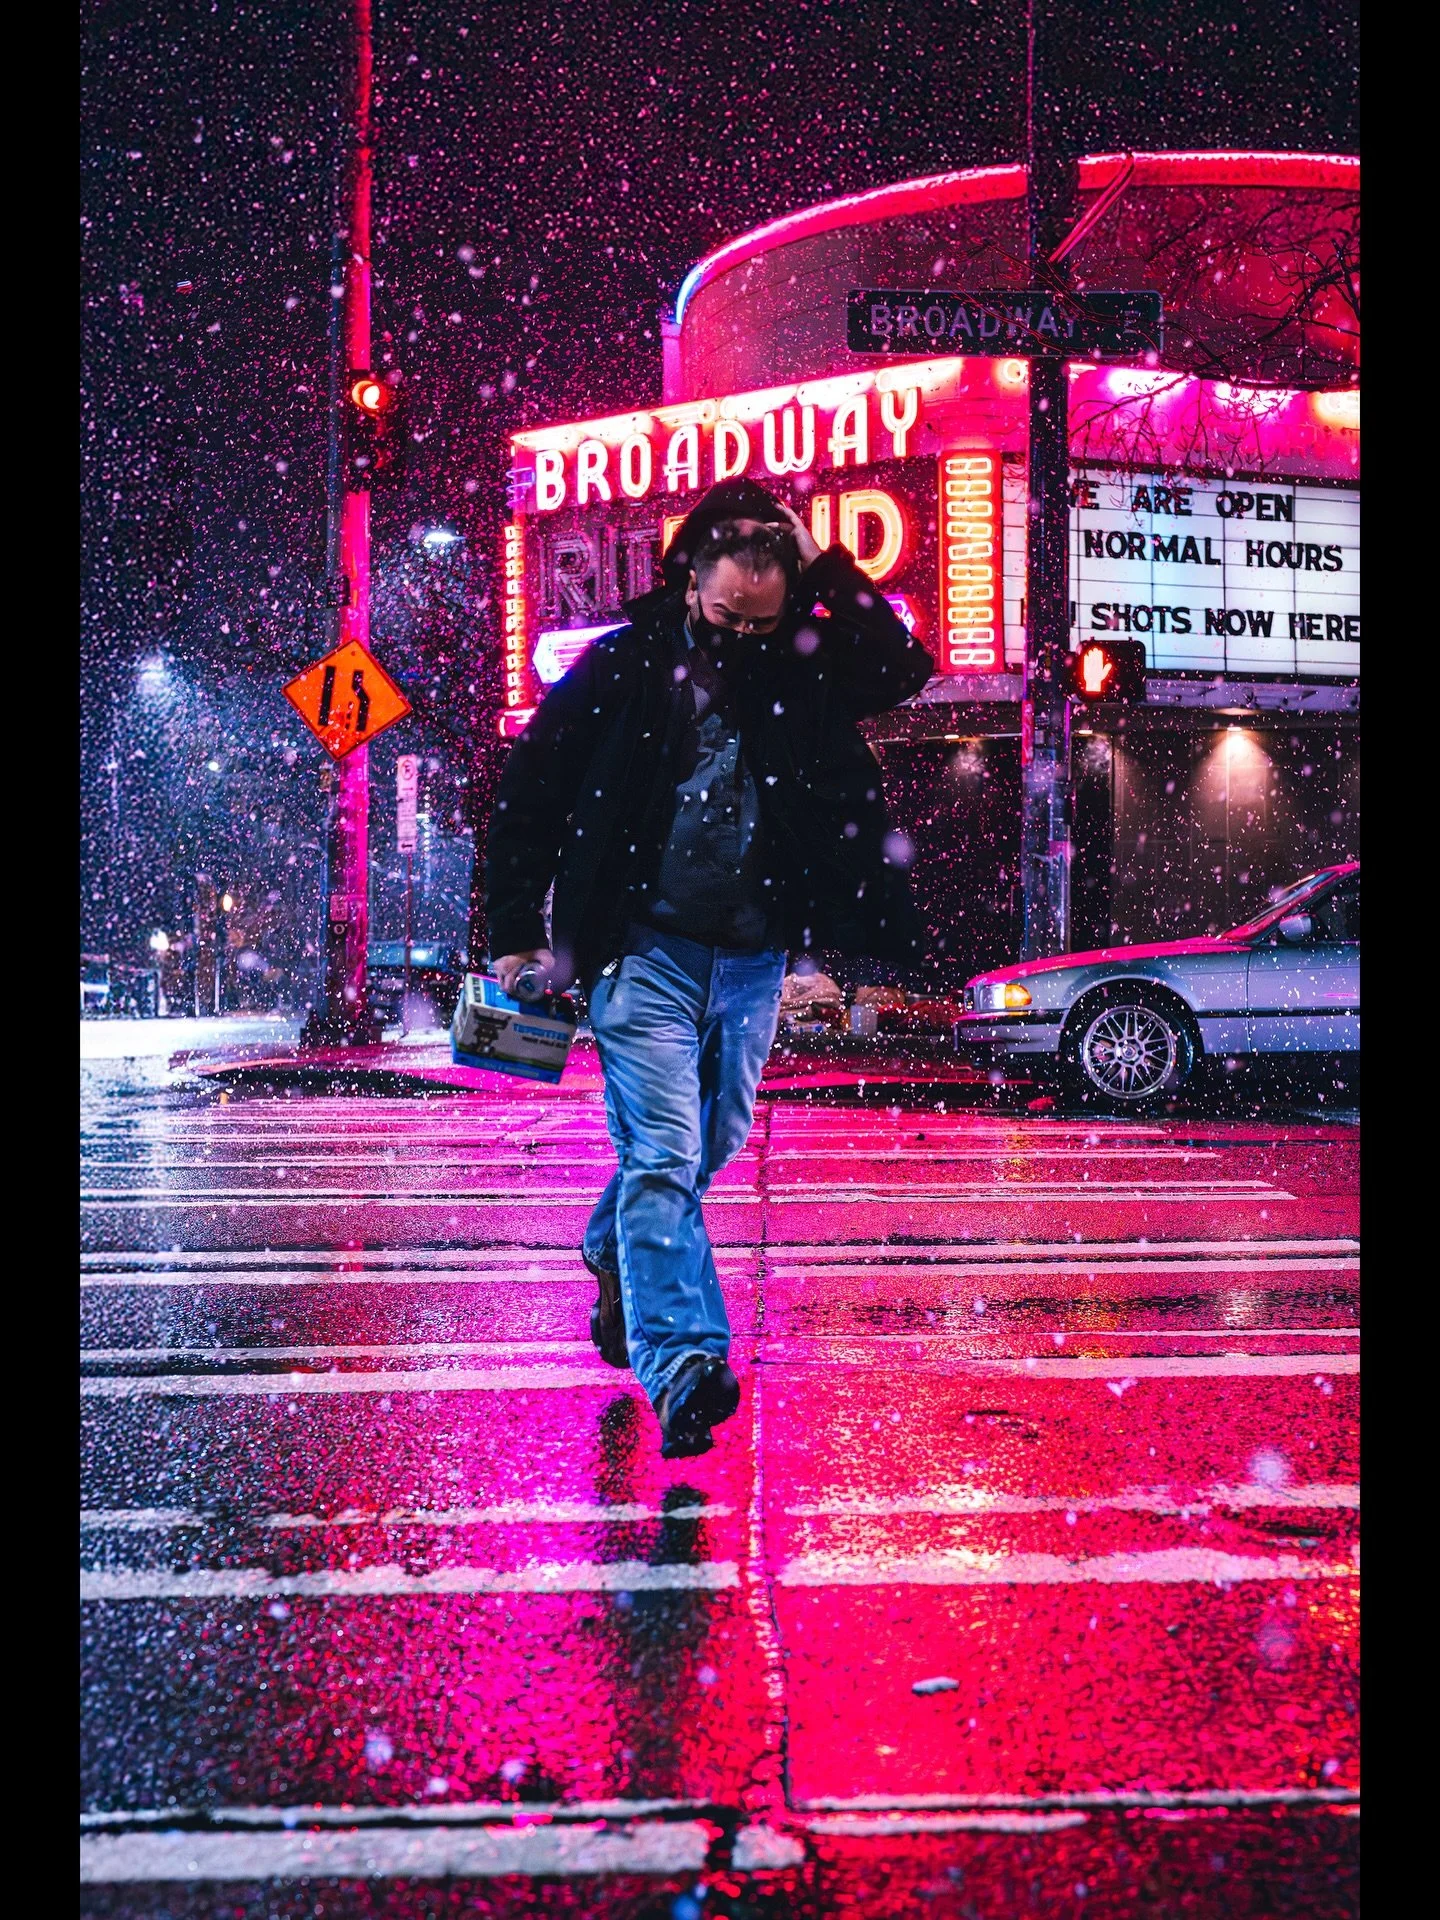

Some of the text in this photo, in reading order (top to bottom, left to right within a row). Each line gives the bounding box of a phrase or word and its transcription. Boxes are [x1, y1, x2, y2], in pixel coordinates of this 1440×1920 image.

[870, 304, 1141, 338] BROADWAY E
[535, 386, 920, 510] BROADWAY
[1131, 484, 1193, 517] ARE
[1216, 491, 1294, 522] OPEN
[811, 489, 904, 581] ID
[1084, 529, 1343, 571] NORMAL HOURS
[1091, 602, 1192, 634] SHOTS
[1205, 608, 1275, 637] NOW
[1288, 612, 1360, 643] HERE
